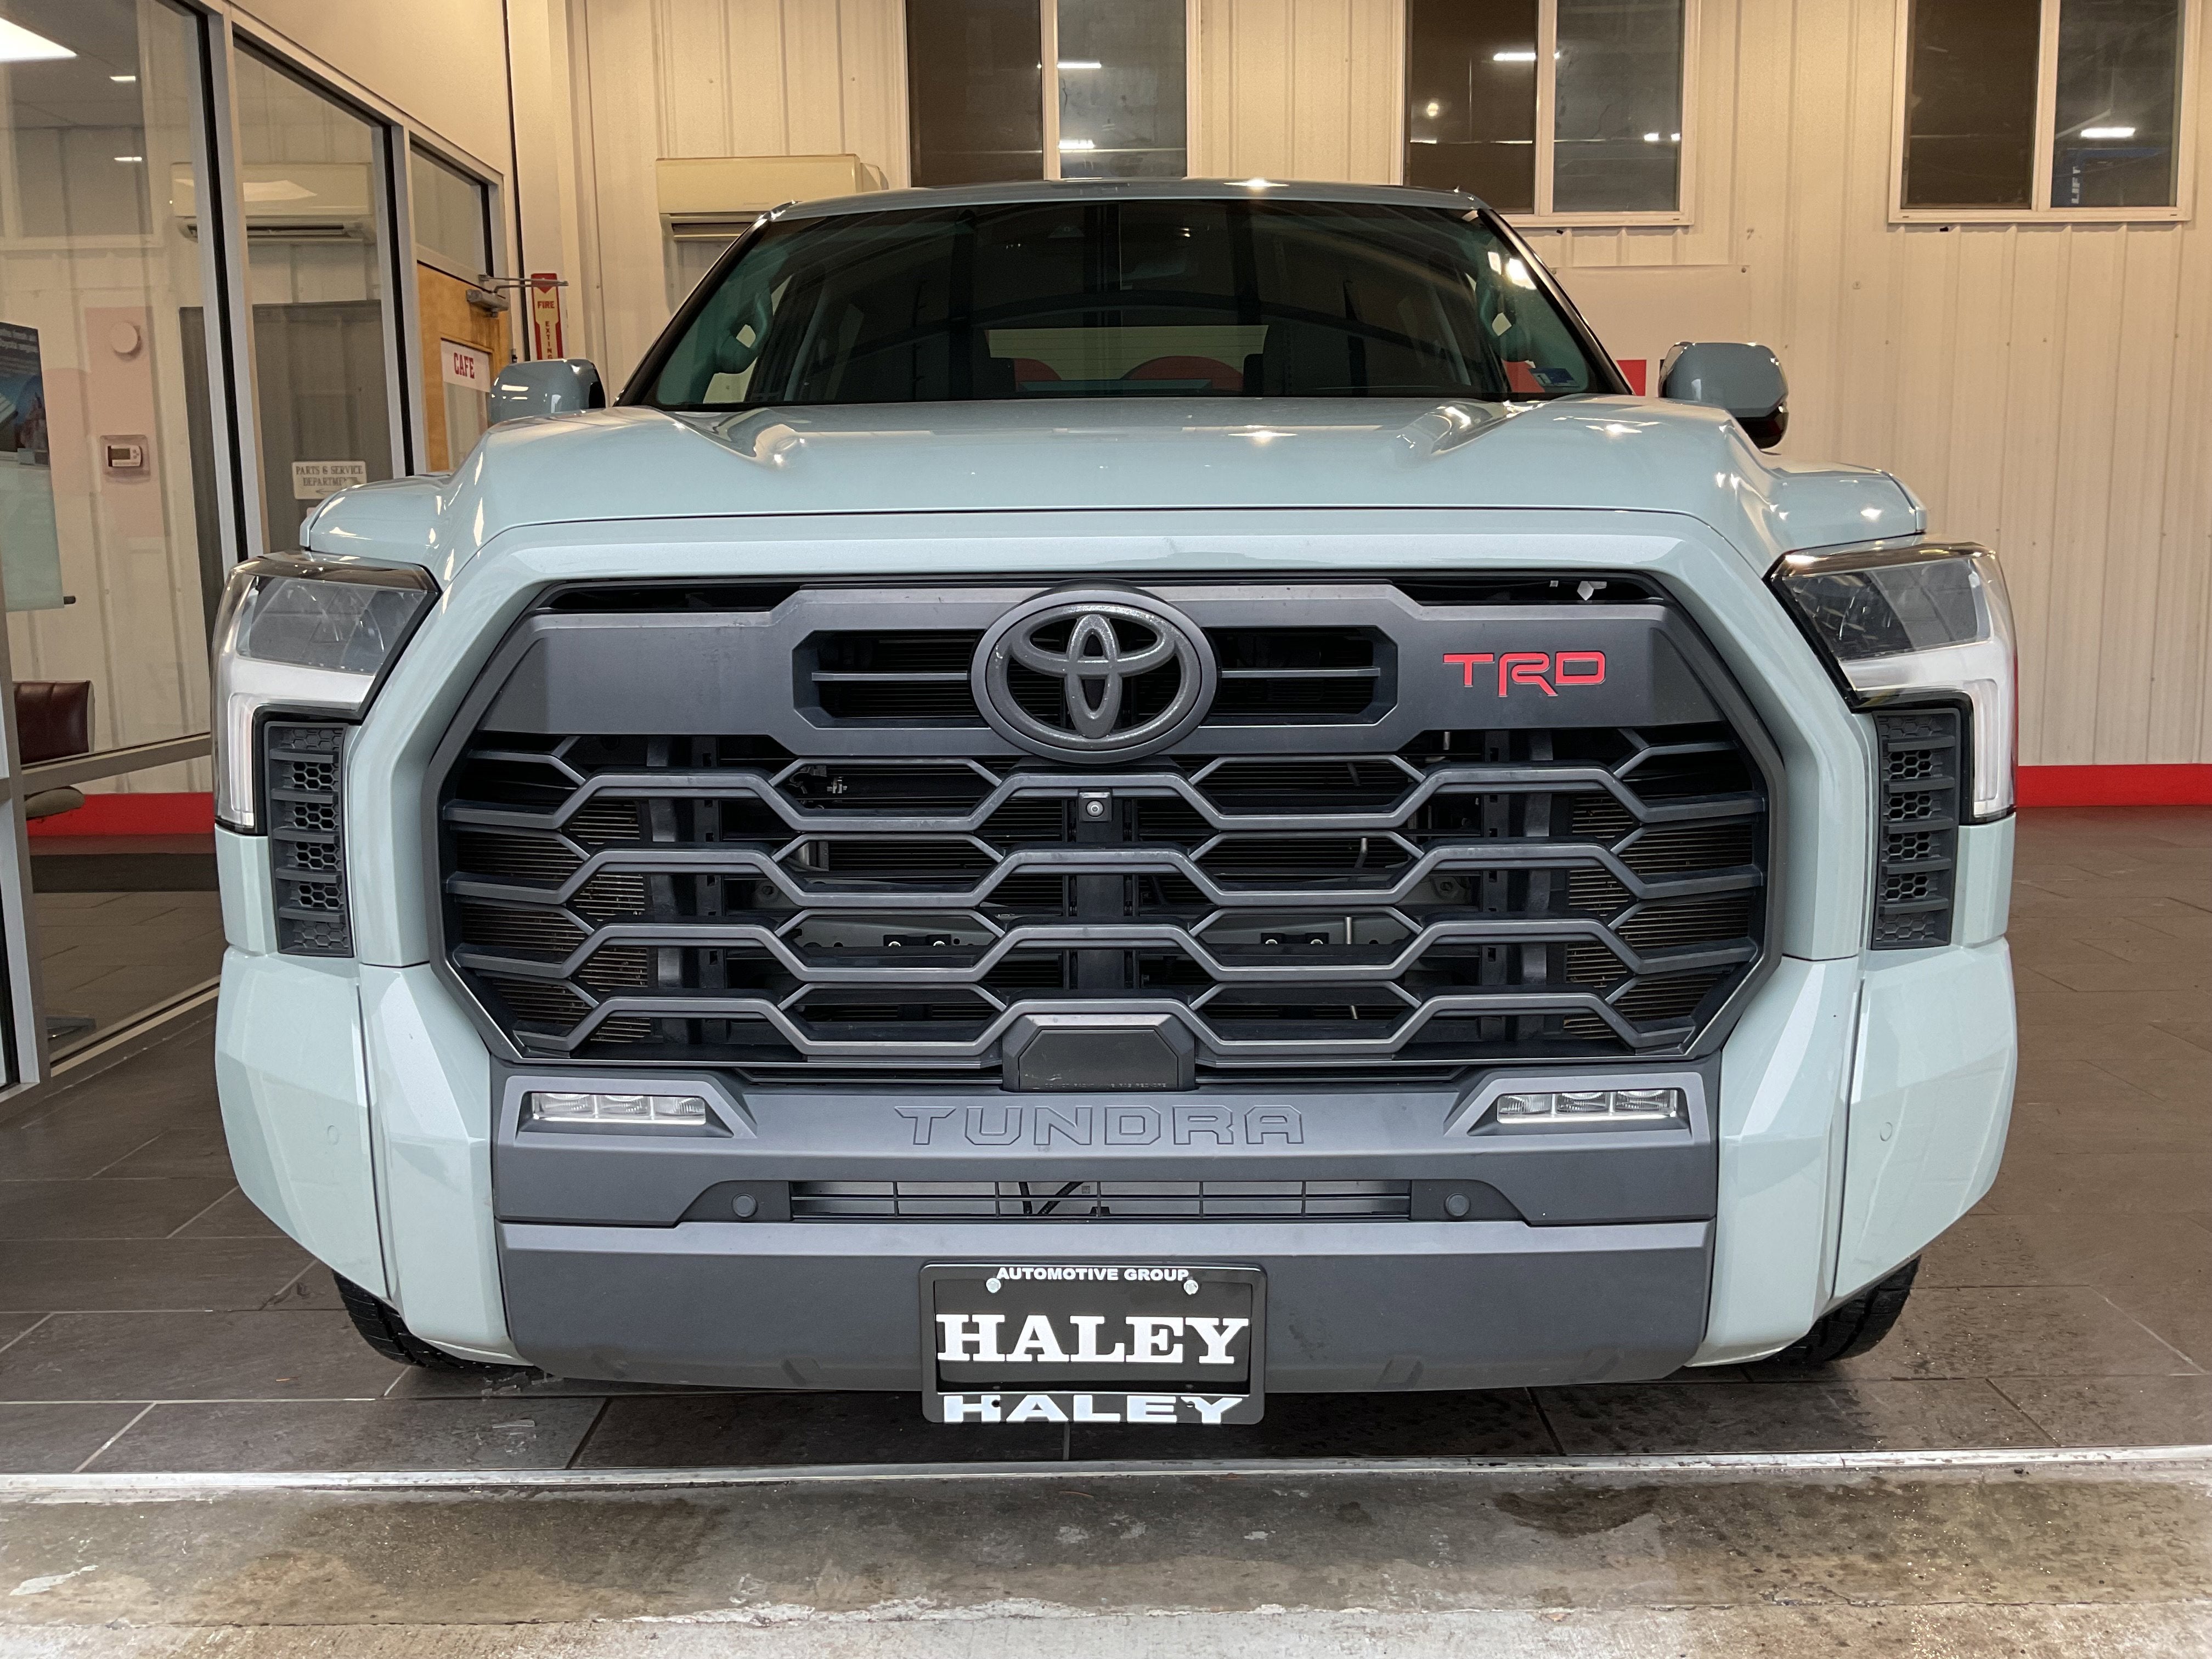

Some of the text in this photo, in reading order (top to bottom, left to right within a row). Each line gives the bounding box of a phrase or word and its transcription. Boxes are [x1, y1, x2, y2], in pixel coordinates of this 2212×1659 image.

[2072, 166, 2081, 204] LIFT
[454, 353, 475, 379] CAFE
[296, 466, 320, 475] PARTS
[331, 466, 363, 474] SERVICE
[303, 477, 356, 486] DEPARTME
[1443, 651, 1606, 697] TRD
[894, 1105, 1304, 1146] TUNDRA
[996, 1267, 1189, 1282] AUTOMOTIVE GROUP
[936, 1314, 1249, 1364] HALEY
[944, 1395, 1243, 1424] HALEY
